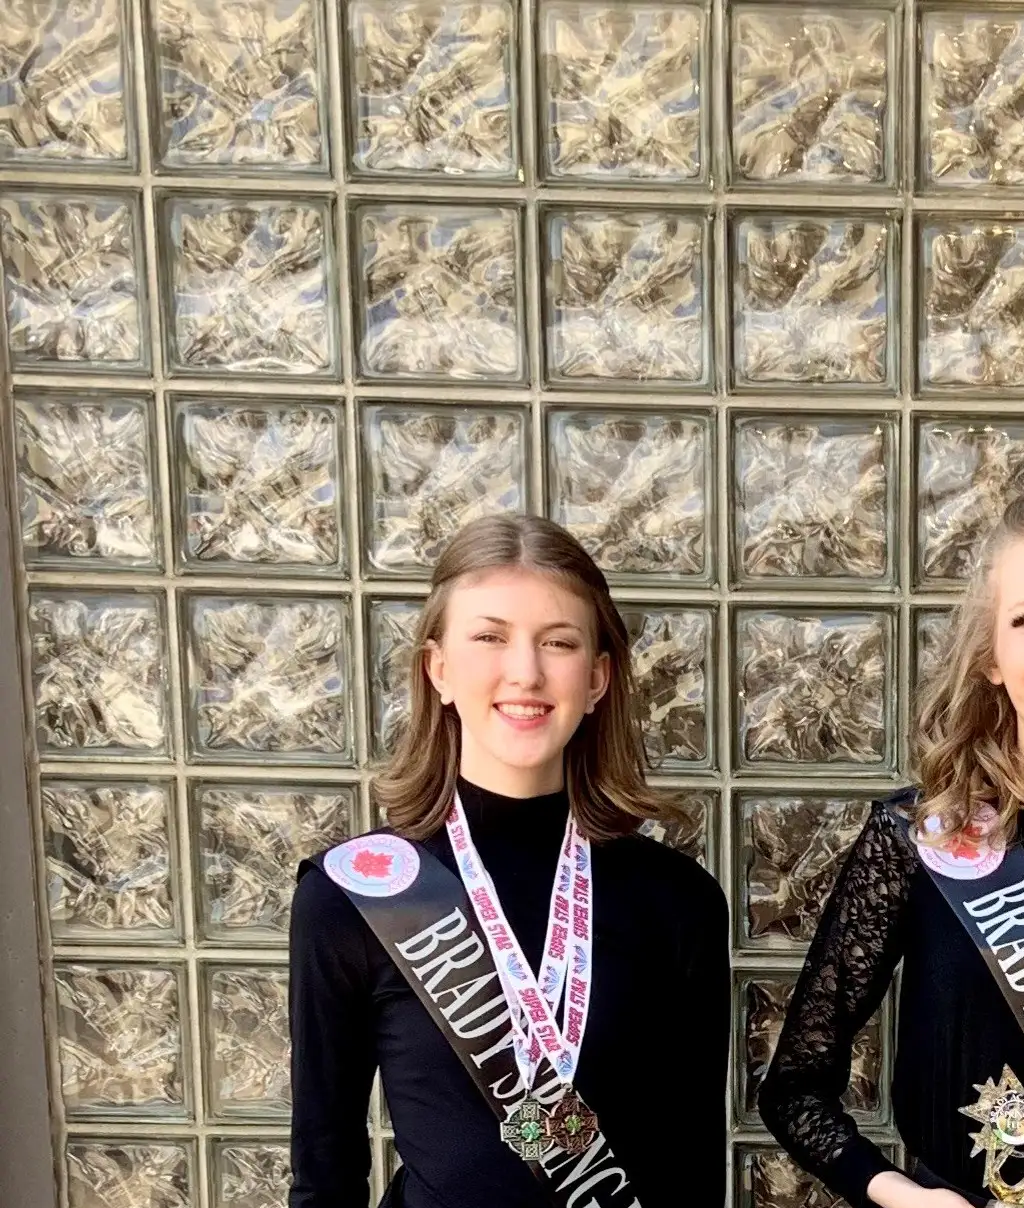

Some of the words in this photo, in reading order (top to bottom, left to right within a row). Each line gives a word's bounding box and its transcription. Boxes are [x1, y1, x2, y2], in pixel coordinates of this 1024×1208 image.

[573, 873, 589, 904] STAR
[471, 886, 499, 922] SUPER
[488, 923, 514, 952] STAR
[554, 894, 569, 923] STAR
[573, 903, 588, 941] SUPER
[548, 924, 568, 961] SUPER
[394, 906, 522, 1070] BRADY
[569, 976, 588, 1008] STAR
[518, 987, 548, 1024] SUPER
[536, 1025, 561, 1053] STAR
[565, 1006, 584, 1048] SUPER
[990, 1096, 1008, 1123] BRADY
